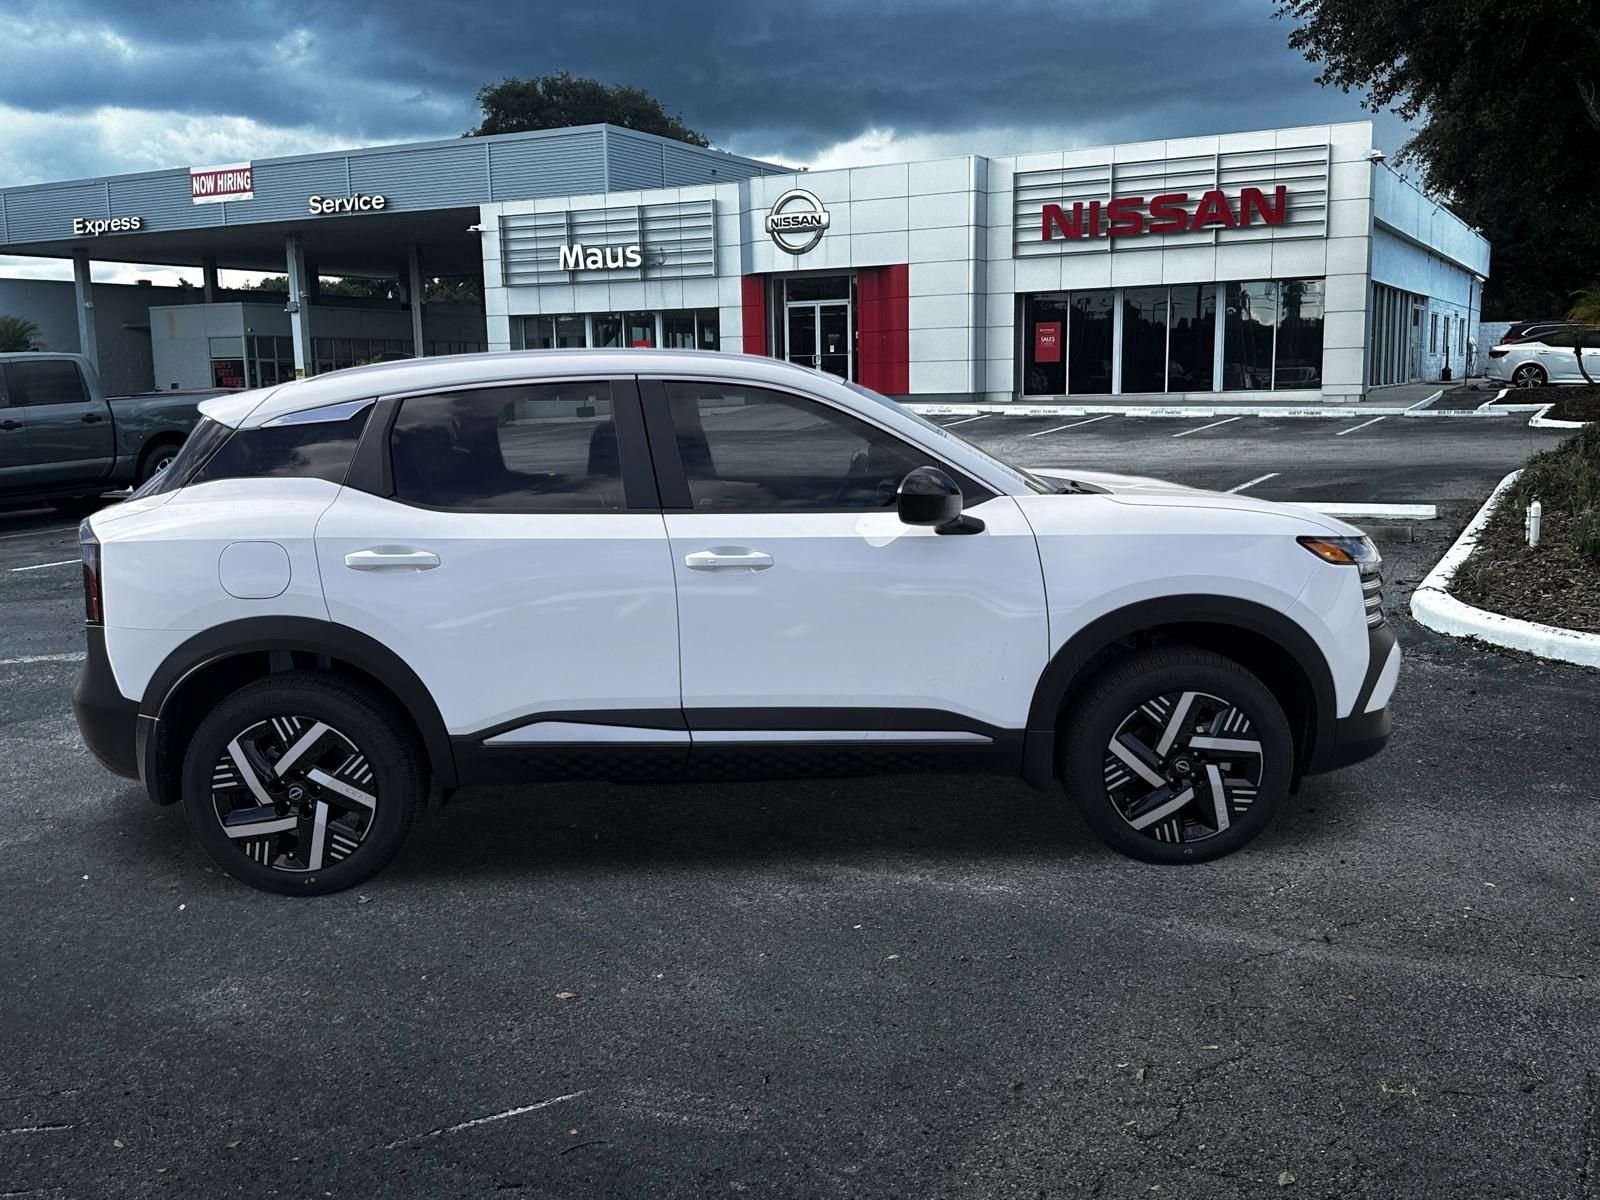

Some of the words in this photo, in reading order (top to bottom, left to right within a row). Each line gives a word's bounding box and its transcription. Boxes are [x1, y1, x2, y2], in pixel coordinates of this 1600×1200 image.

[192, 174, 215, 195] NOW
[217, 171, 251, 192] HIRING
[308, 193, 386, 215] Service
[1041, 185, 1287, 241] NISSAN
[73, 215, 141, 236] Express
[770, 214, 823, 229] NISSAN
[559, 243, 642, 271] Maus
[223, 376, 244, 387] FREE
